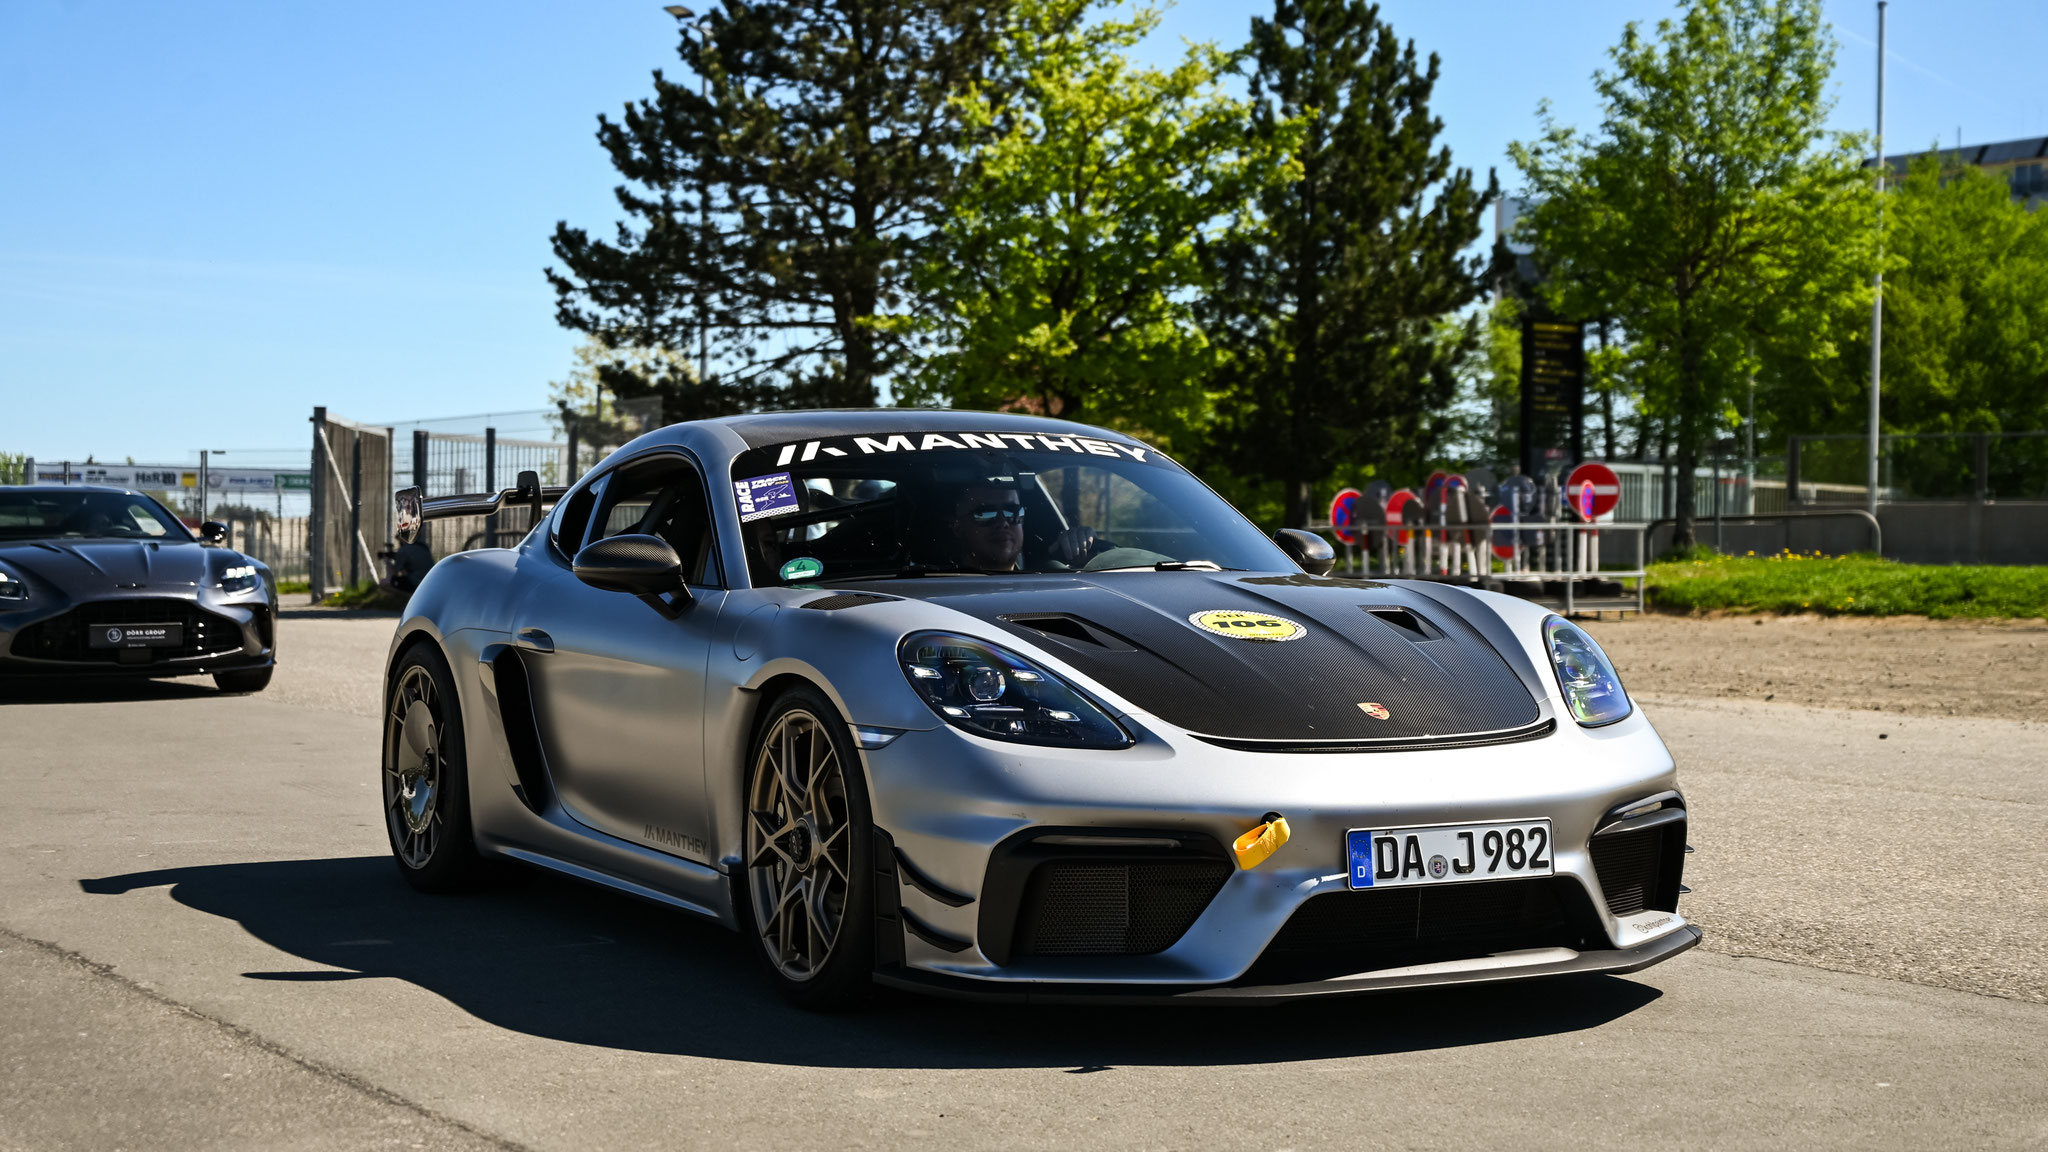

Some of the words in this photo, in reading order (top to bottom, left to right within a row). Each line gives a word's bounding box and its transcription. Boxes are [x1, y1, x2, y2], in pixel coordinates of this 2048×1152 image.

[853, 433, 1148, 463] MANTHEY
[735, 481, 756, 513] RACE
[796, 561, 806, 571] 4
[1212, 620, 1282, 629] 106
[656, 826, 707, 856] MANTHEY
[1374, 834, 1426, 880] DA
[1453, 831, 1476, 874] J
[1483, 826, 1550, 872] 982
[1357, 865, 1366, 878] D
